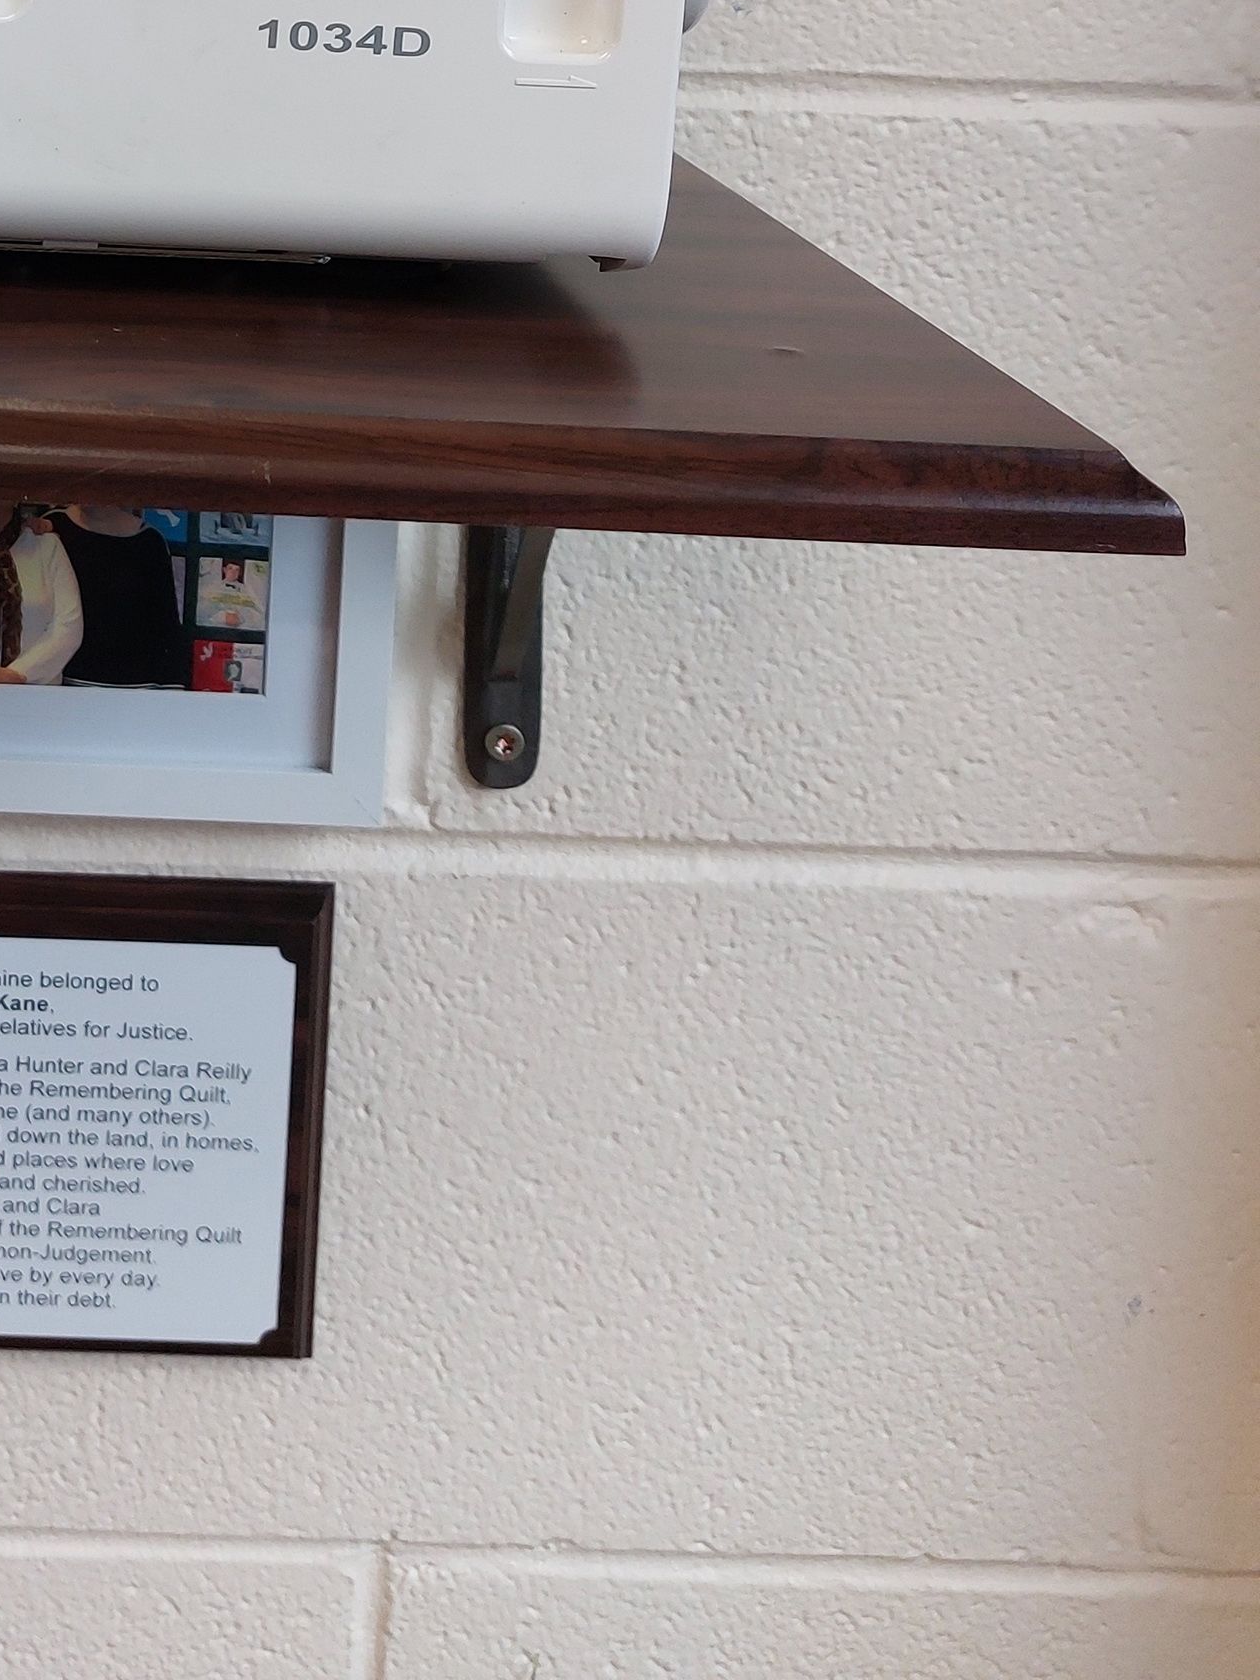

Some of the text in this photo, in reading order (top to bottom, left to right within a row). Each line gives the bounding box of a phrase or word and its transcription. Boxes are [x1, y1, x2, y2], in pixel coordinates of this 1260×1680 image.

[256, 18, 432, 58] 1034D
[40, 971, 133, 994] belonged
[140, 975, 159, 991] to
[83, 1020, 110, 1038] for
[116, 1022, 193, 1040] Justice.
[16, 1055, 84, 1074] Hunter
[90, 1059, 127, 1075] and
[135, 1060, 188, 1078] Clara
[196, 1062, 251, 1084] Reilly
[29, 1080, 171, 1105] Remembering
[179, 1085, 230, 1104] Quilt,
[25, 1104, 69, 1124] (and
[77, 1109, 132, 1127] many
[7, 1127, 60, 1143] down
[67, 1128, 98, 1145] the
[106, 1130, 153, 1149] land,
[162, 1132, 178, 1148] in
[12, 1150, 77, 1169] places
[84, 1153, 145, 1171] where
[153, 1155, 193, 1172] love
[42, 1175, 145, 1194] cherished.
[2, 1197, 39, 1214] and
[47, 1197, 100, 1215] Clara
[9, 1220, 40, 1237] the
[47, 1221, 188, 1247] Remembering
[195, 1226, 241, 1244] Quilt
[30, 1266, 52, 1286] by
[59, 1271, 113, 1288] every
[17, 1289, 61, 1306] their
[67, 1291, 115, 1308] debt.
